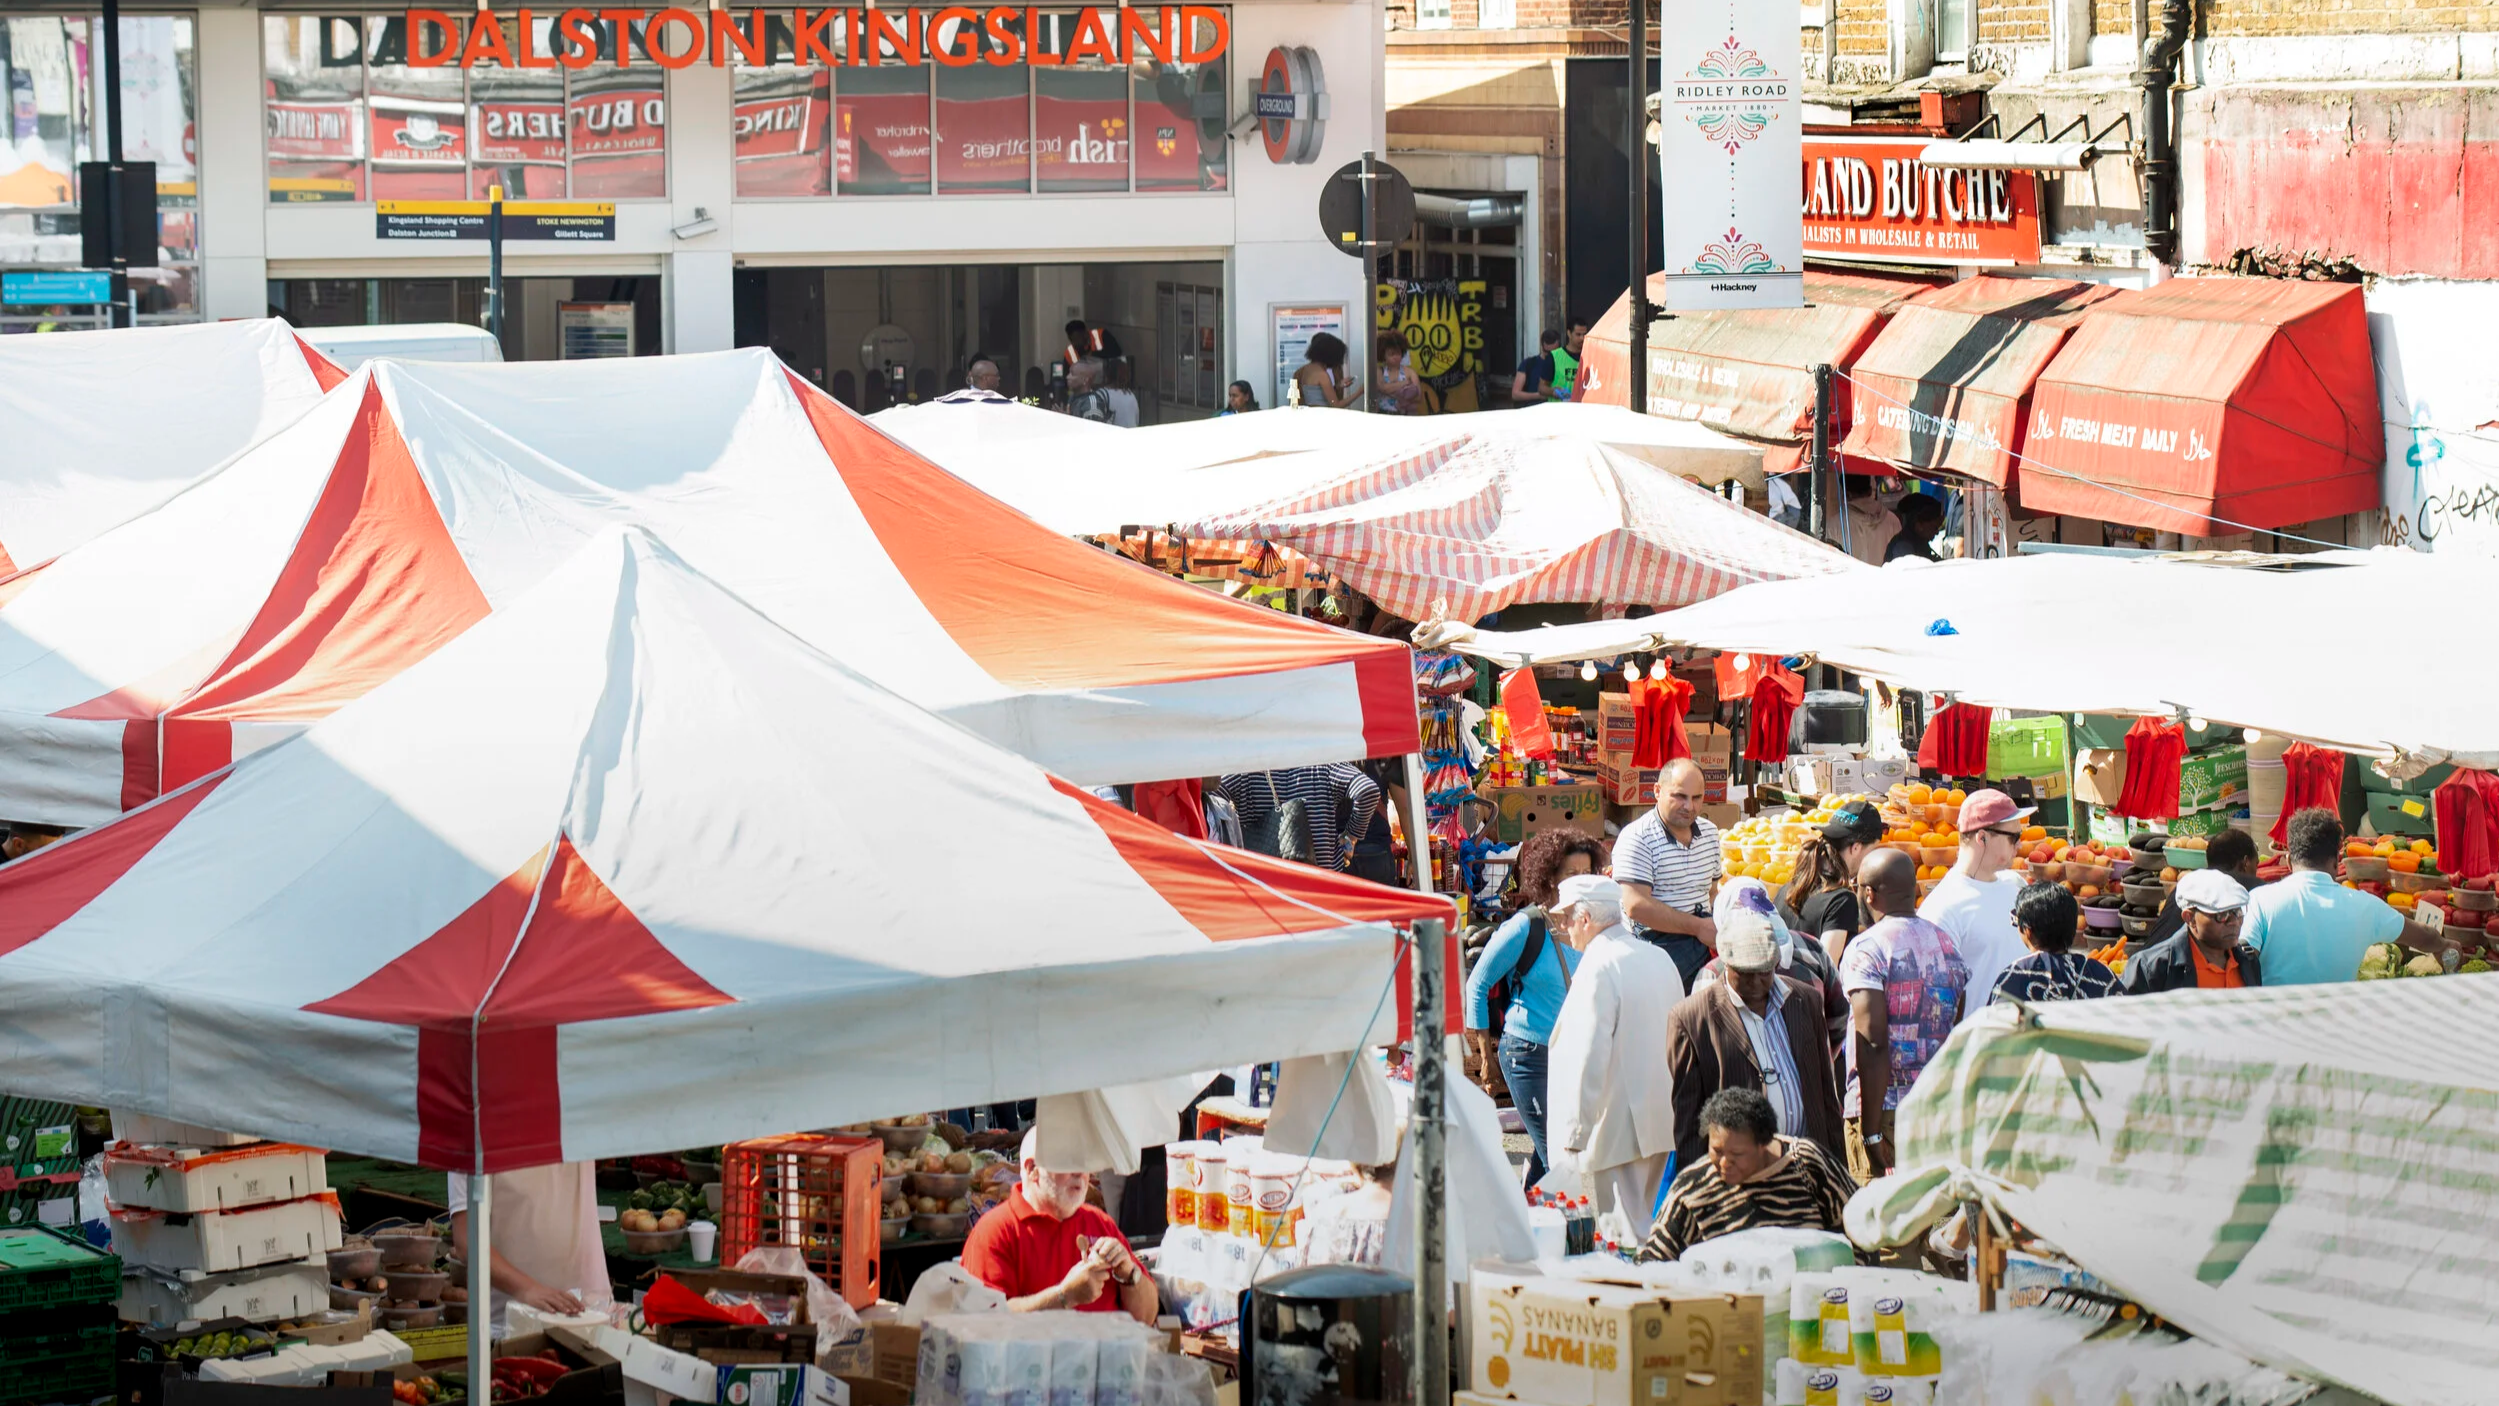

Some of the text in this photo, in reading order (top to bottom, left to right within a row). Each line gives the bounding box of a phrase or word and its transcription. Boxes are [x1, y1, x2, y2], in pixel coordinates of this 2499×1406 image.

[405, 6, 1229, 69] DALSTON KINGSLAND
[1677, 85, 1786, 97] RIDLEY ROAD
[1260, 98, 1294, 113] OVERGROUND
[388, 216, 484, 227] Kingsland Shopping Centre
[536, 218, 604, 226] STOKE NEWINGTON
[388, 229, 449, 238] Dalston Junction
[555, 230, 604, 240] Gillett Square
[1845, 228, 1856, 244] IN
[1860, 228, 1921, 247] WHOLESALE
[1925, 232, 1935, 246] &
[1938, 232, 1980, 250] RETAIL
[1720, 283, 1757, 293] Hackney
[1652, 357, 1702, 381] WHOLESALE
[1711, 366, 1740, 388] RETAIL
[1878, 404, 1930, 435] CATERING
[2059, 416, 2178, 453] FRESH MEAT DAILY
[1523, 1305, 1617, 1340] BANANAS
[1524, 1332, 1617, 1372] SH PRATT
